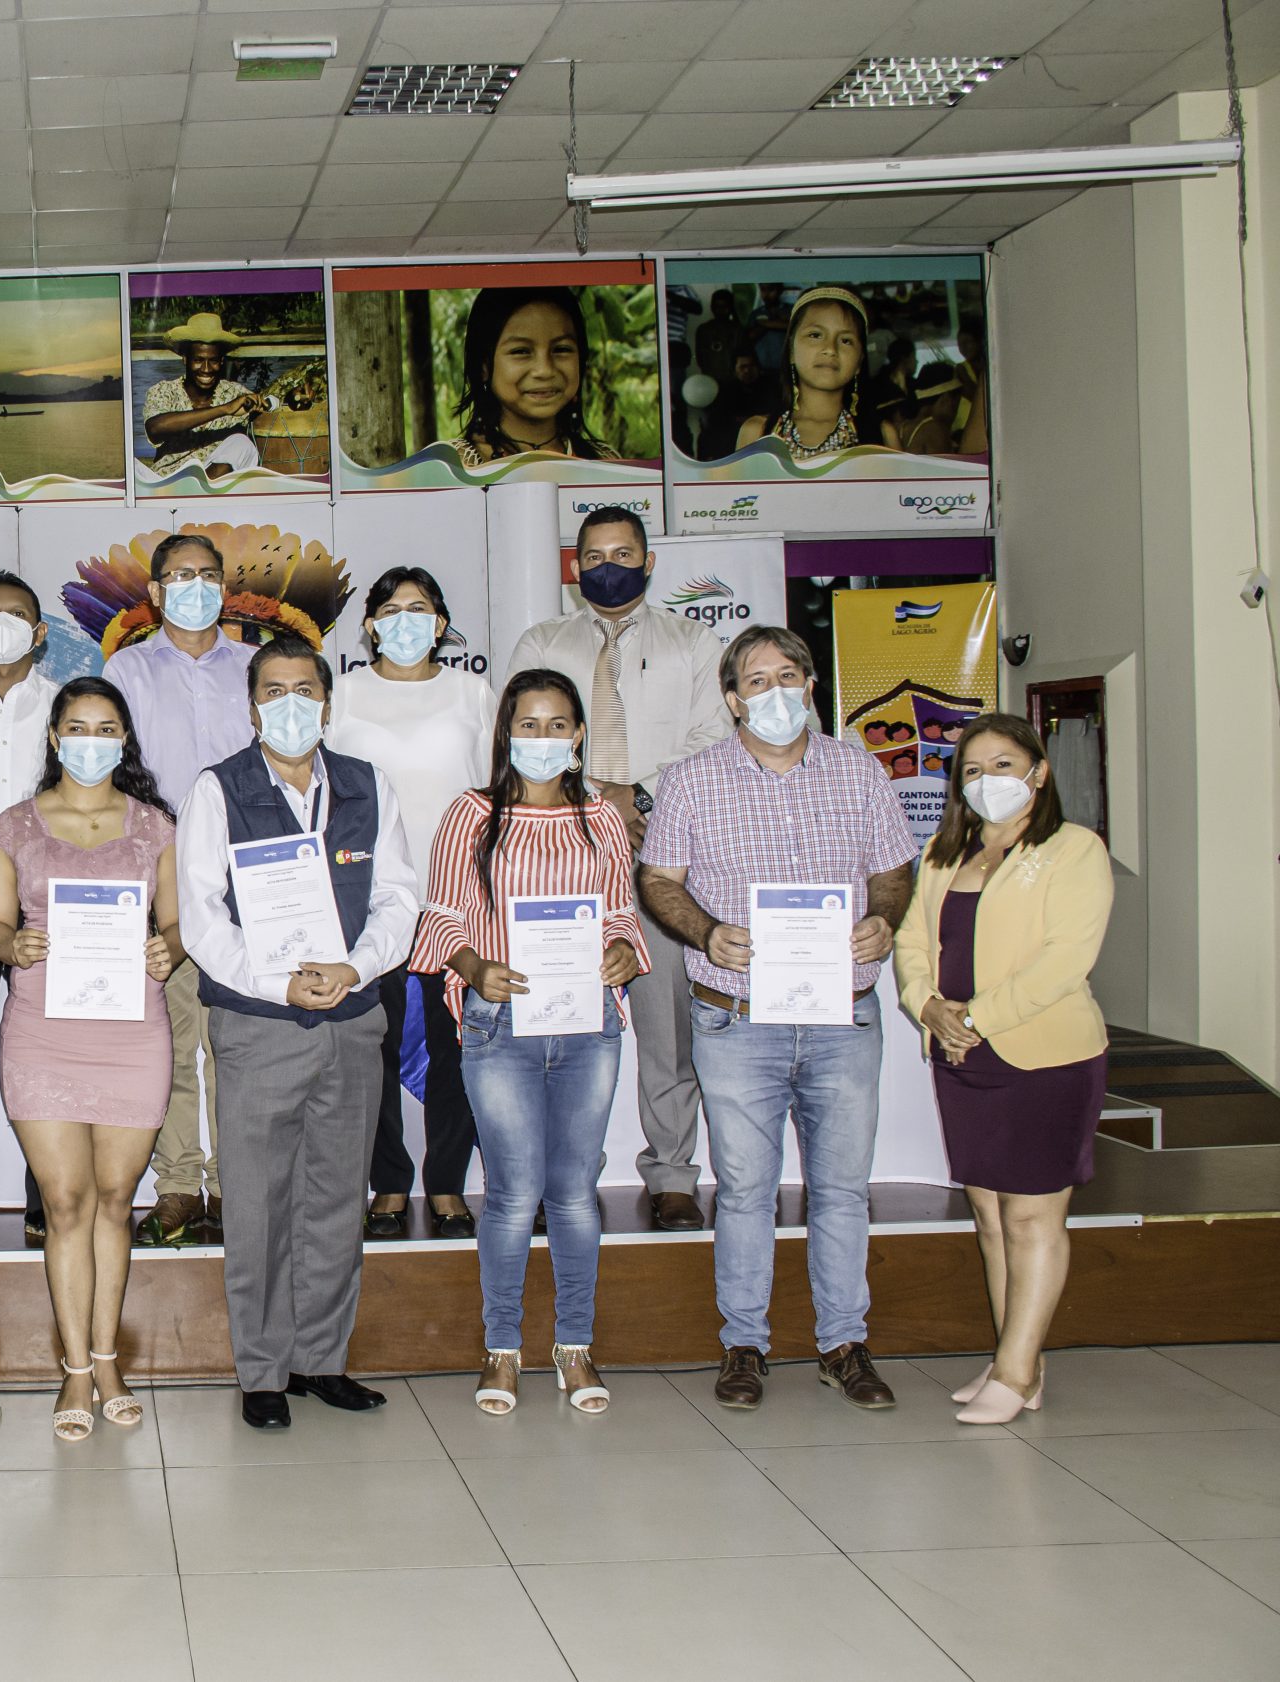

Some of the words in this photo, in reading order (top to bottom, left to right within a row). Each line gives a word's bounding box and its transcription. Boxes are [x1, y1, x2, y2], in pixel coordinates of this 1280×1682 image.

[899, 495, 932, 509] Lago
[935, 493, 970, 507] agrio
[683, 510, 716, 518] LAGO
[720, 509, 759, 517] AGRIO
[684, 602, 750, 628] agrio
[898, 791, 948, 799] CANTONAL
